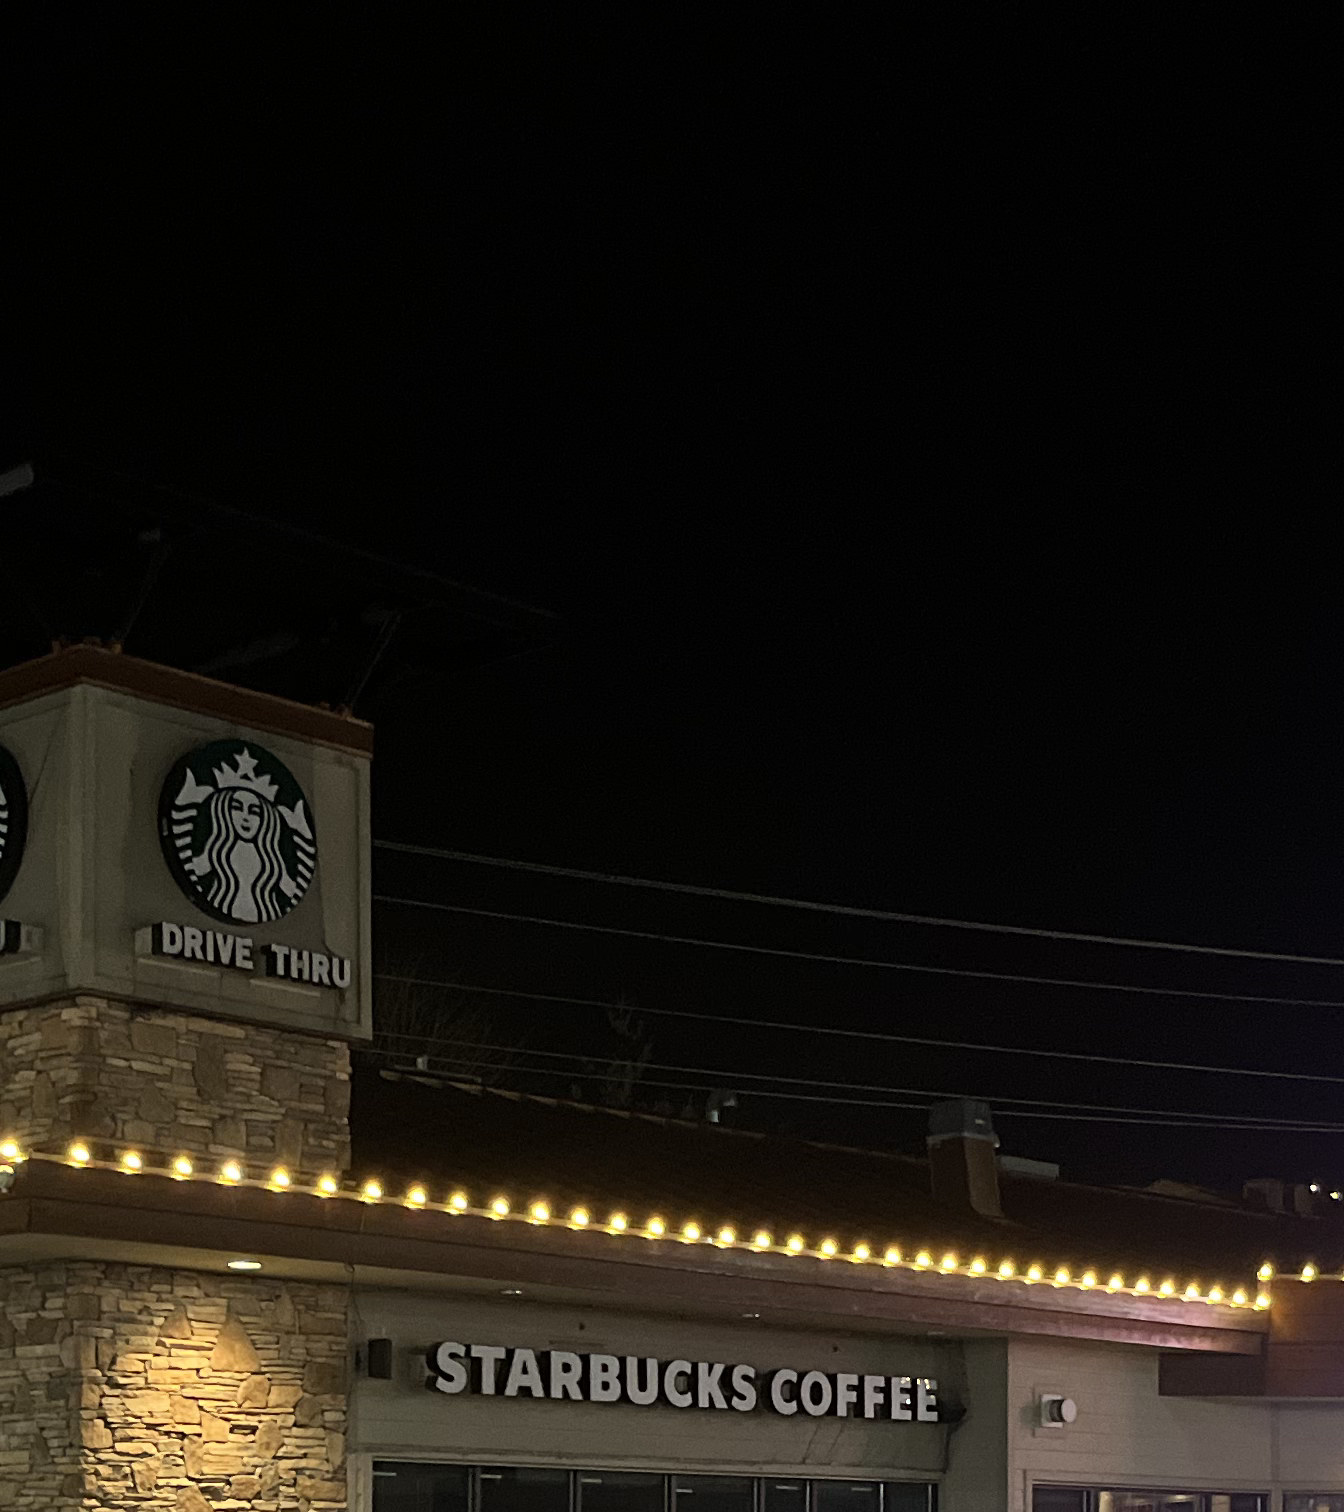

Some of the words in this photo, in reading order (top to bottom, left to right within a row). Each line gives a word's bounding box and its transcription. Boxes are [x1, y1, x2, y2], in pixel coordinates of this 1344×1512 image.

[161, 921, 254, 970] DRIVE
[270, 943, 351, 988] THRU
[434, 1341, 757, 1412] STARBUCKS
[771, 1369, 938, 1422] COFFEE
